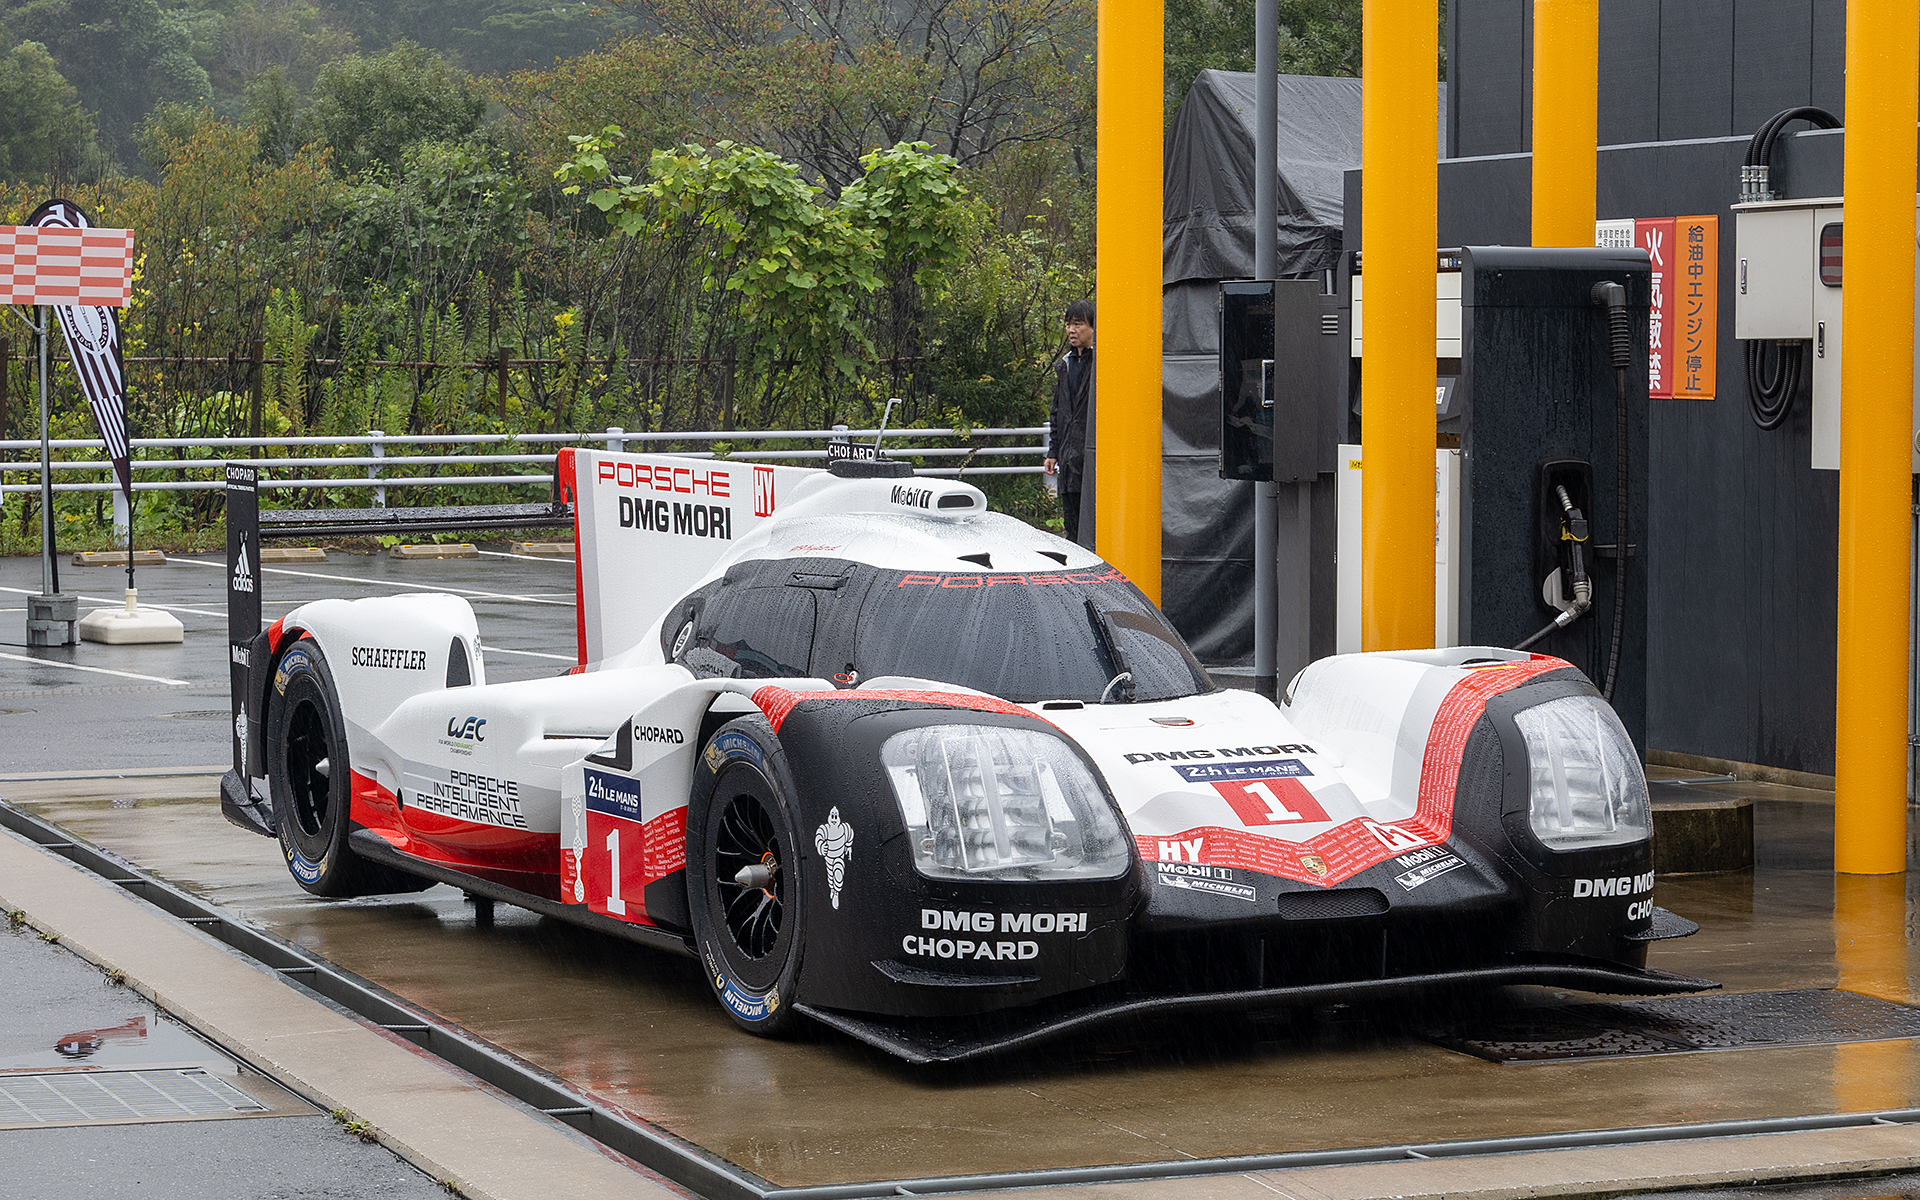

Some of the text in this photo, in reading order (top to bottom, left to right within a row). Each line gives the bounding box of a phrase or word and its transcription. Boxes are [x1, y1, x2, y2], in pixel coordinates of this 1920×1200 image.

[1685, 225, 1705, 391] 給油中エンジン停止
[226, 467, 254, 482] CHOPARD
[598, 461, 730, 497] PORSCHE
[754, 468, 774, 517] HY
[891, 485, 921, 507] Mobil
[619, 496, 732, 540] DMG MORI
[232, 573, 254, 592] adidas
[898, 568, 1129, 589] PORSCHE
[284, 655, 309, 671] MICHELIN
[352, 647, 426, 670] SCHAEFFLER
[447, 716, 487, 742] WEC
[634, 725, 684, 744] CHOPARD
[722, 738, 760, 760] MICHELIN
[1123, 743, 1318, 765] DMG MORI
[1225, 767, 1247, 775] LE
[1250, 765, 1300, 774] MANS
[450, 769, 519, 796] PORSCHE
[433, 781, 520, 812] INTELLIGENT
[605, 788, 616, 802] LE
[615, 790, 639, 807] MANS
[1243, 782, 1303, 822] 1
[416, 792, 528, 828] PERFORMANCE
[1158, 837, 1204, 863] HY
[1395, 849, 1437, 868] Mobil
[606, 828, 626, 916] 1
[1158, 863, 1211, 878] Mobil
[1420, 858, 1459, 876] MICHELIN
[1191, 881, 1253, 895] MICHELIN
[1573, 869, 1654, 898] DMG MO
[1627, 896, 1653, 920] CHO
[921, 909, 1088, 932] DMG MORI
[902, 935, 1040, 960] CHOPARD
[724, 989, 763, 1016] MICHELIN
